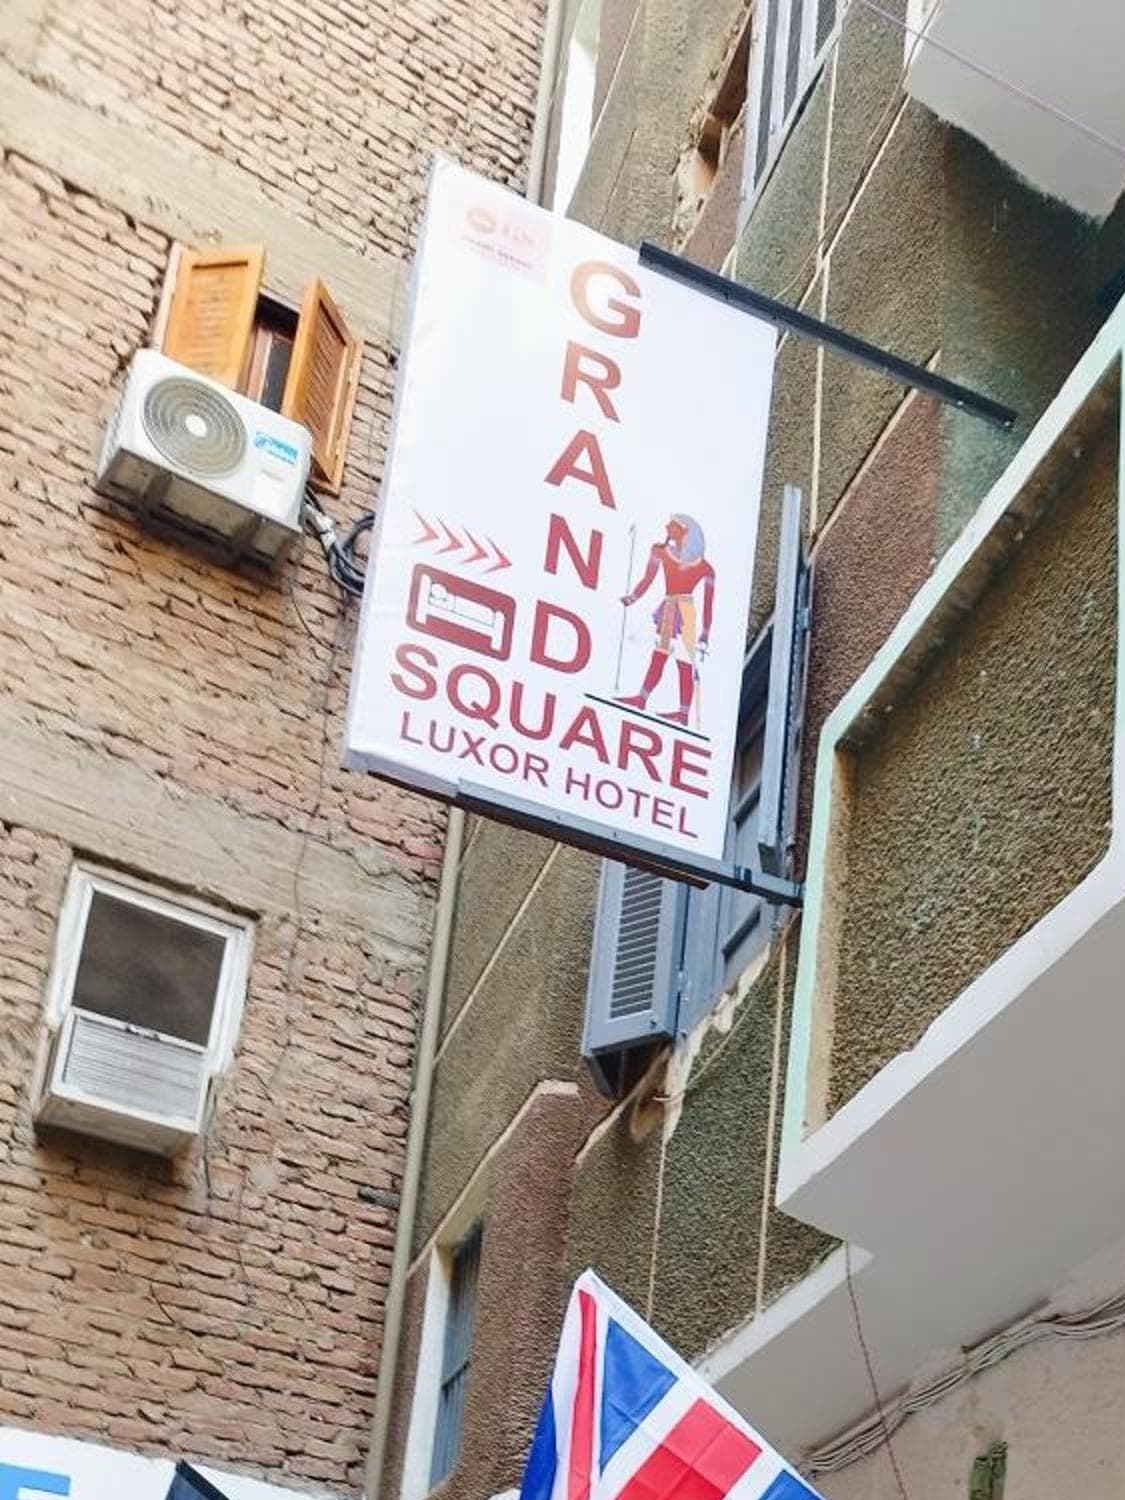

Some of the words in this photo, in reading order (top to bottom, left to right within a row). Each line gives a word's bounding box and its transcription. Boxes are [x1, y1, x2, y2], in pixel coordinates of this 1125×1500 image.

[529, 259, 642, 675] GRAND
[390, 643, 713, 799] SQUARE
[400, 711, 549, 787] LUXOR
[565, 767, 699, 838] HOTEL
